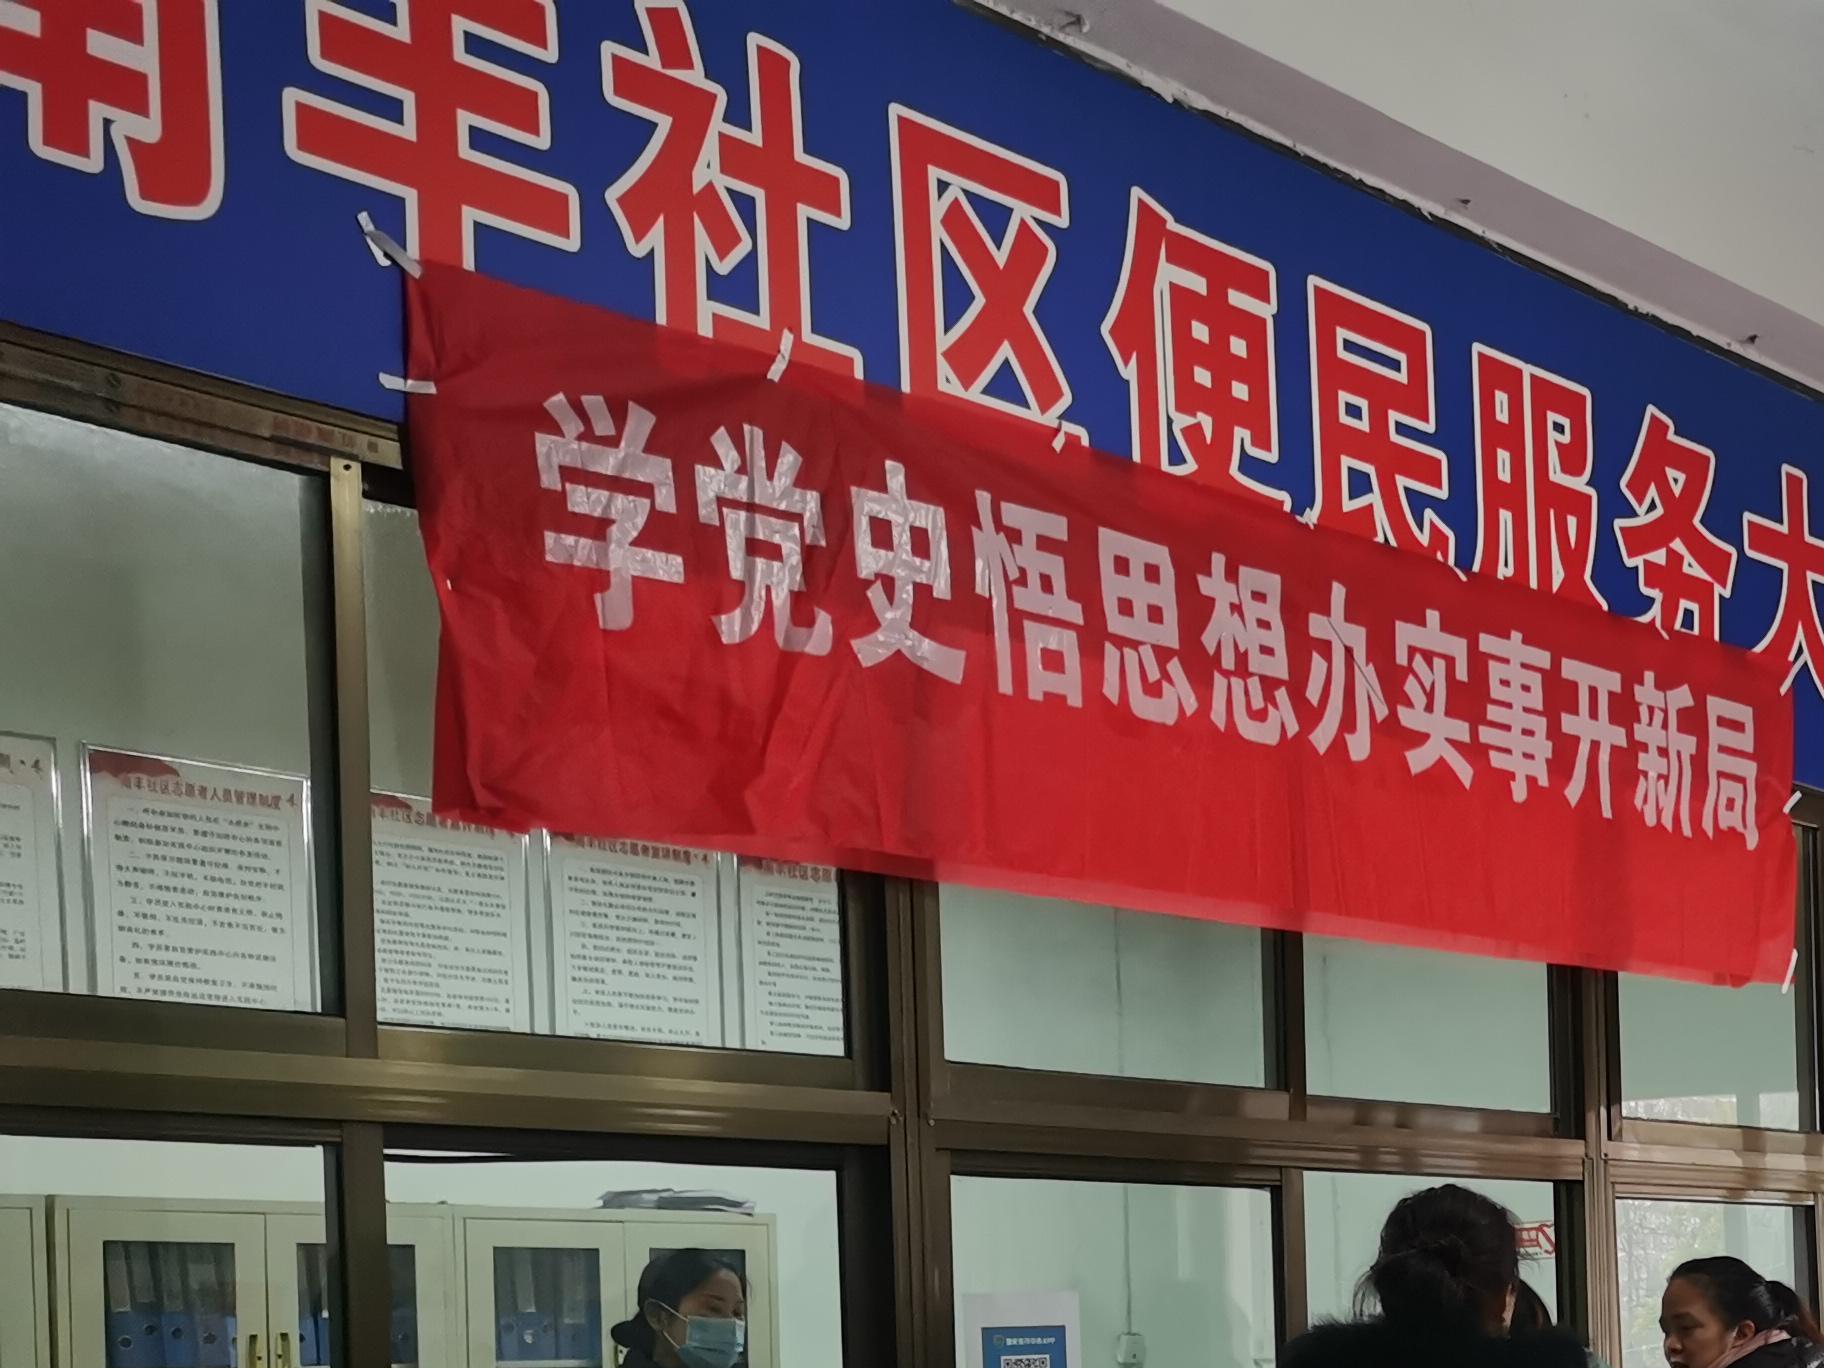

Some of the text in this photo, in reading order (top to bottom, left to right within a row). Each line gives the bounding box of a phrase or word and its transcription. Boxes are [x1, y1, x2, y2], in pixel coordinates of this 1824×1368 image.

[534, 392, 1759, 850] 学党史悟思想办实事开新局
